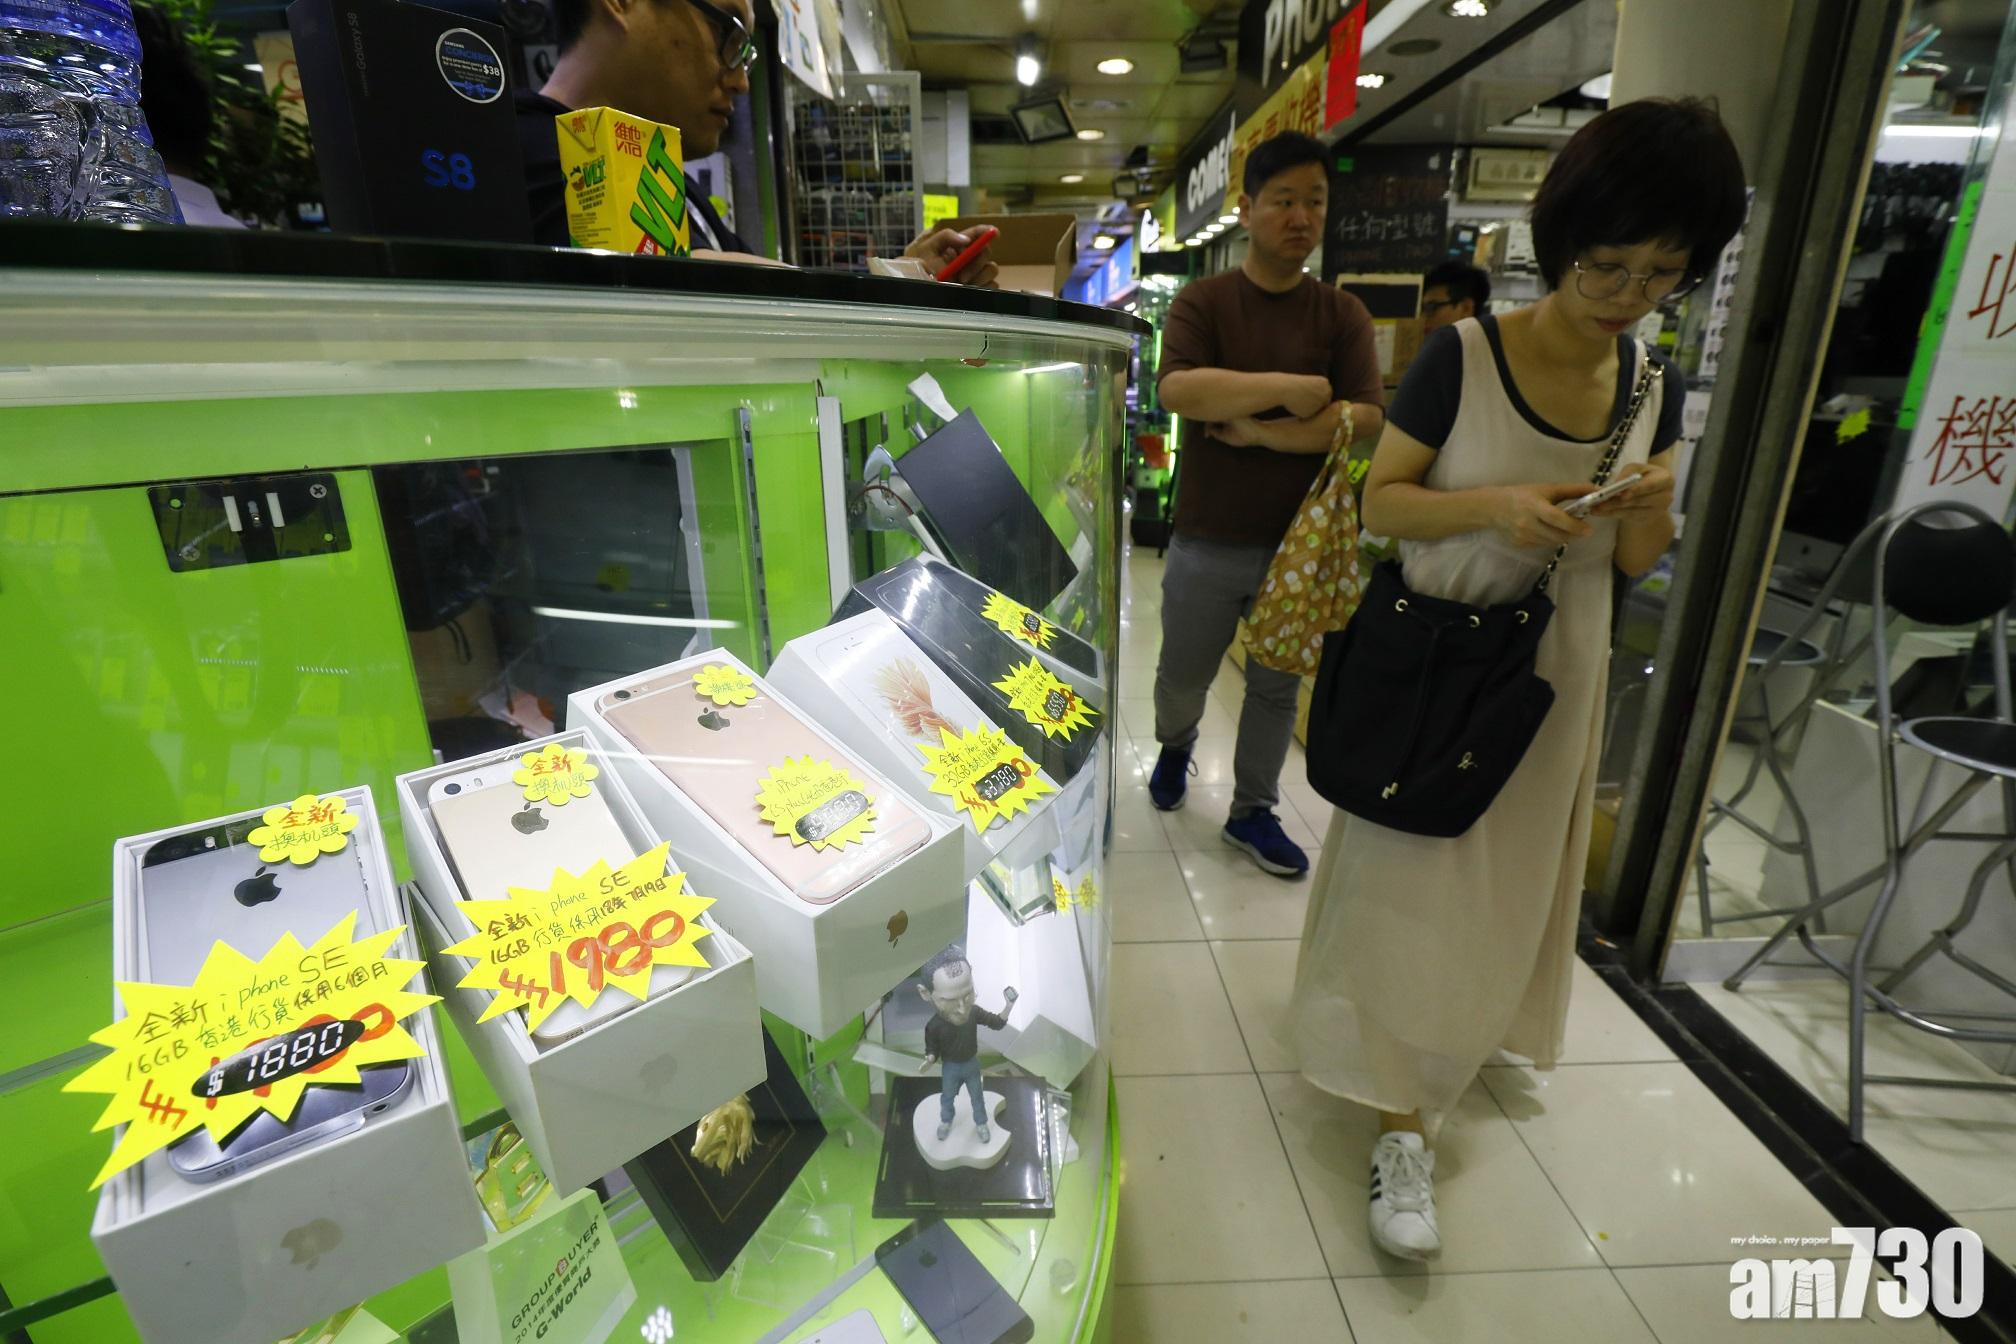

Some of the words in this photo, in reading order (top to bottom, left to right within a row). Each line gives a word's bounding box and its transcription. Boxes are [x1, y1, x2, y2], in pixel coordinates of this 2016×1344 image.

[482, 63, 500, 77] $38
[614, 120, 641, 141] 維他
[421, 147, 477, 191] S8
[529, 754, 572, 776] 全新
[279, 803, 338, 829] 全新
[487, 913, 533, 941] 全新
[599, 870, 630, 895] SE
[490, 938, 531, 965] 16GB
[135, 998, 209, 1044] 全新
[299, 945, 348, 983] SE
[126, 1039, 189, 1081] 16GB
[535, 1266, 592, 1340] G-World
